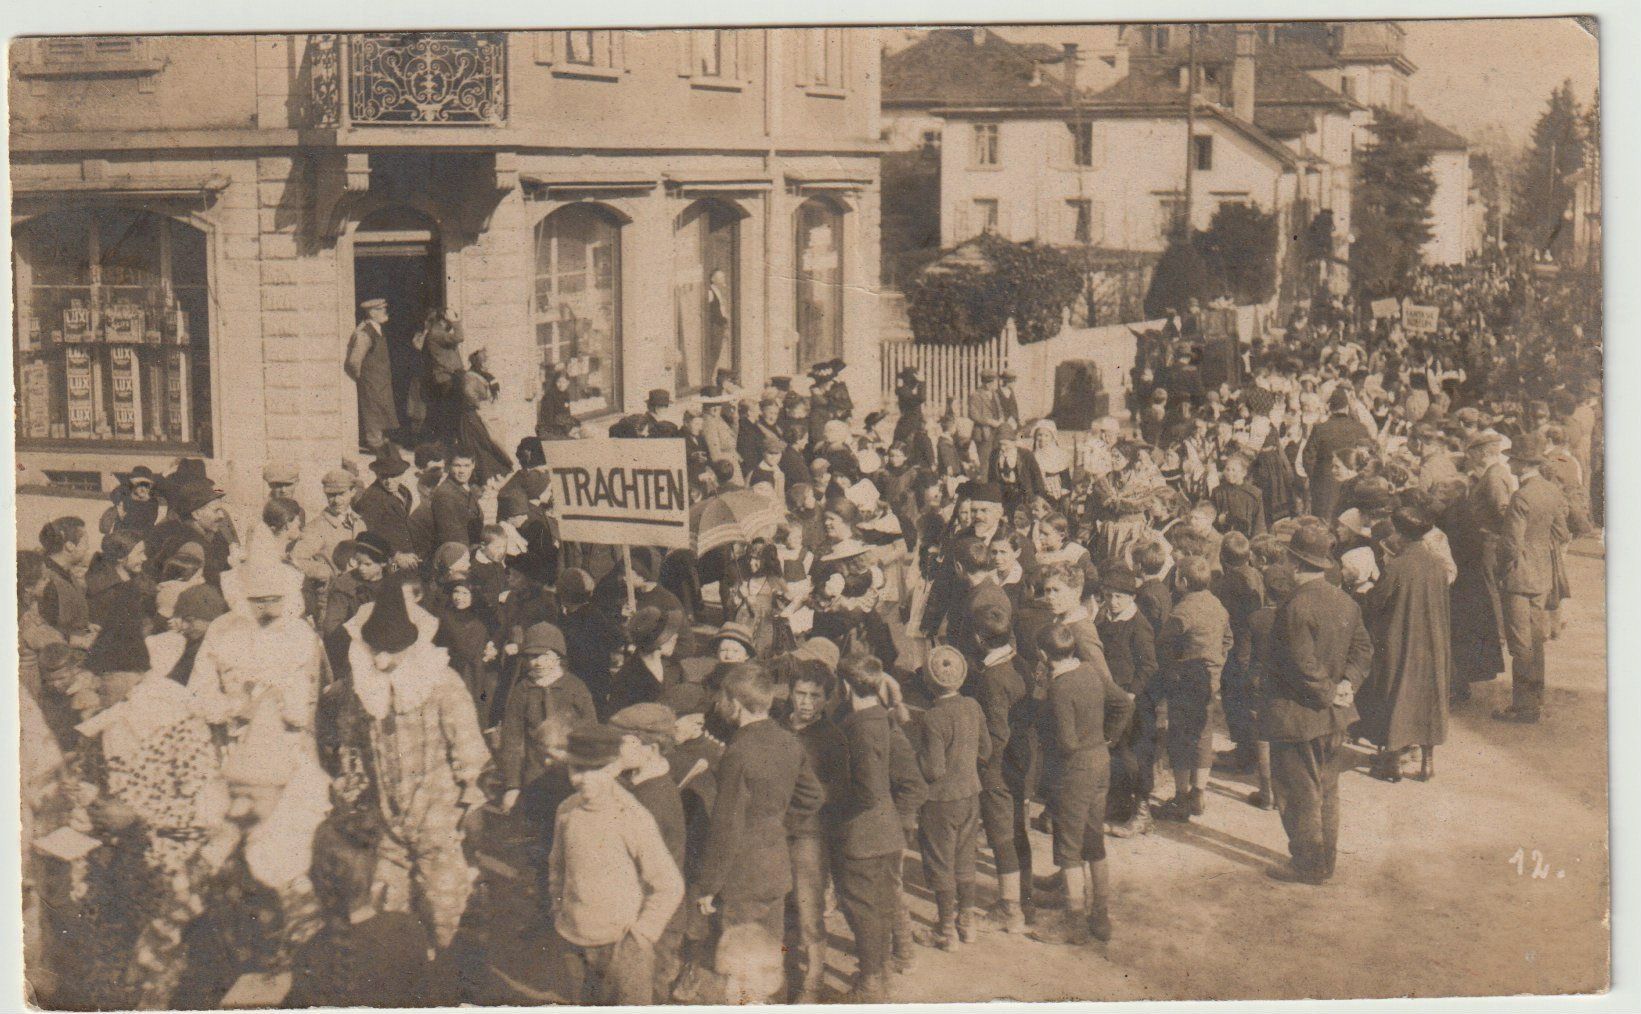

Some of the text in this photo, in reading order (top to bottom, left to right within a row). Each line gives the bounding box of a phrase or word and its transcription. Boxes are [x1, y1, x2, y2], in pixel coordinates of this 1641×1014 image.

[66, 311, 86, 322] LUX
[113, 348, 131, 359] LUX
[70, 377, 90, 389] LUX
[114, 379, 133, 391] LUX
[71, 409, 90, 421] LUX
[116, 410, 134, 422] LUX
[552, 467, 685, 511] TRACHTEN
